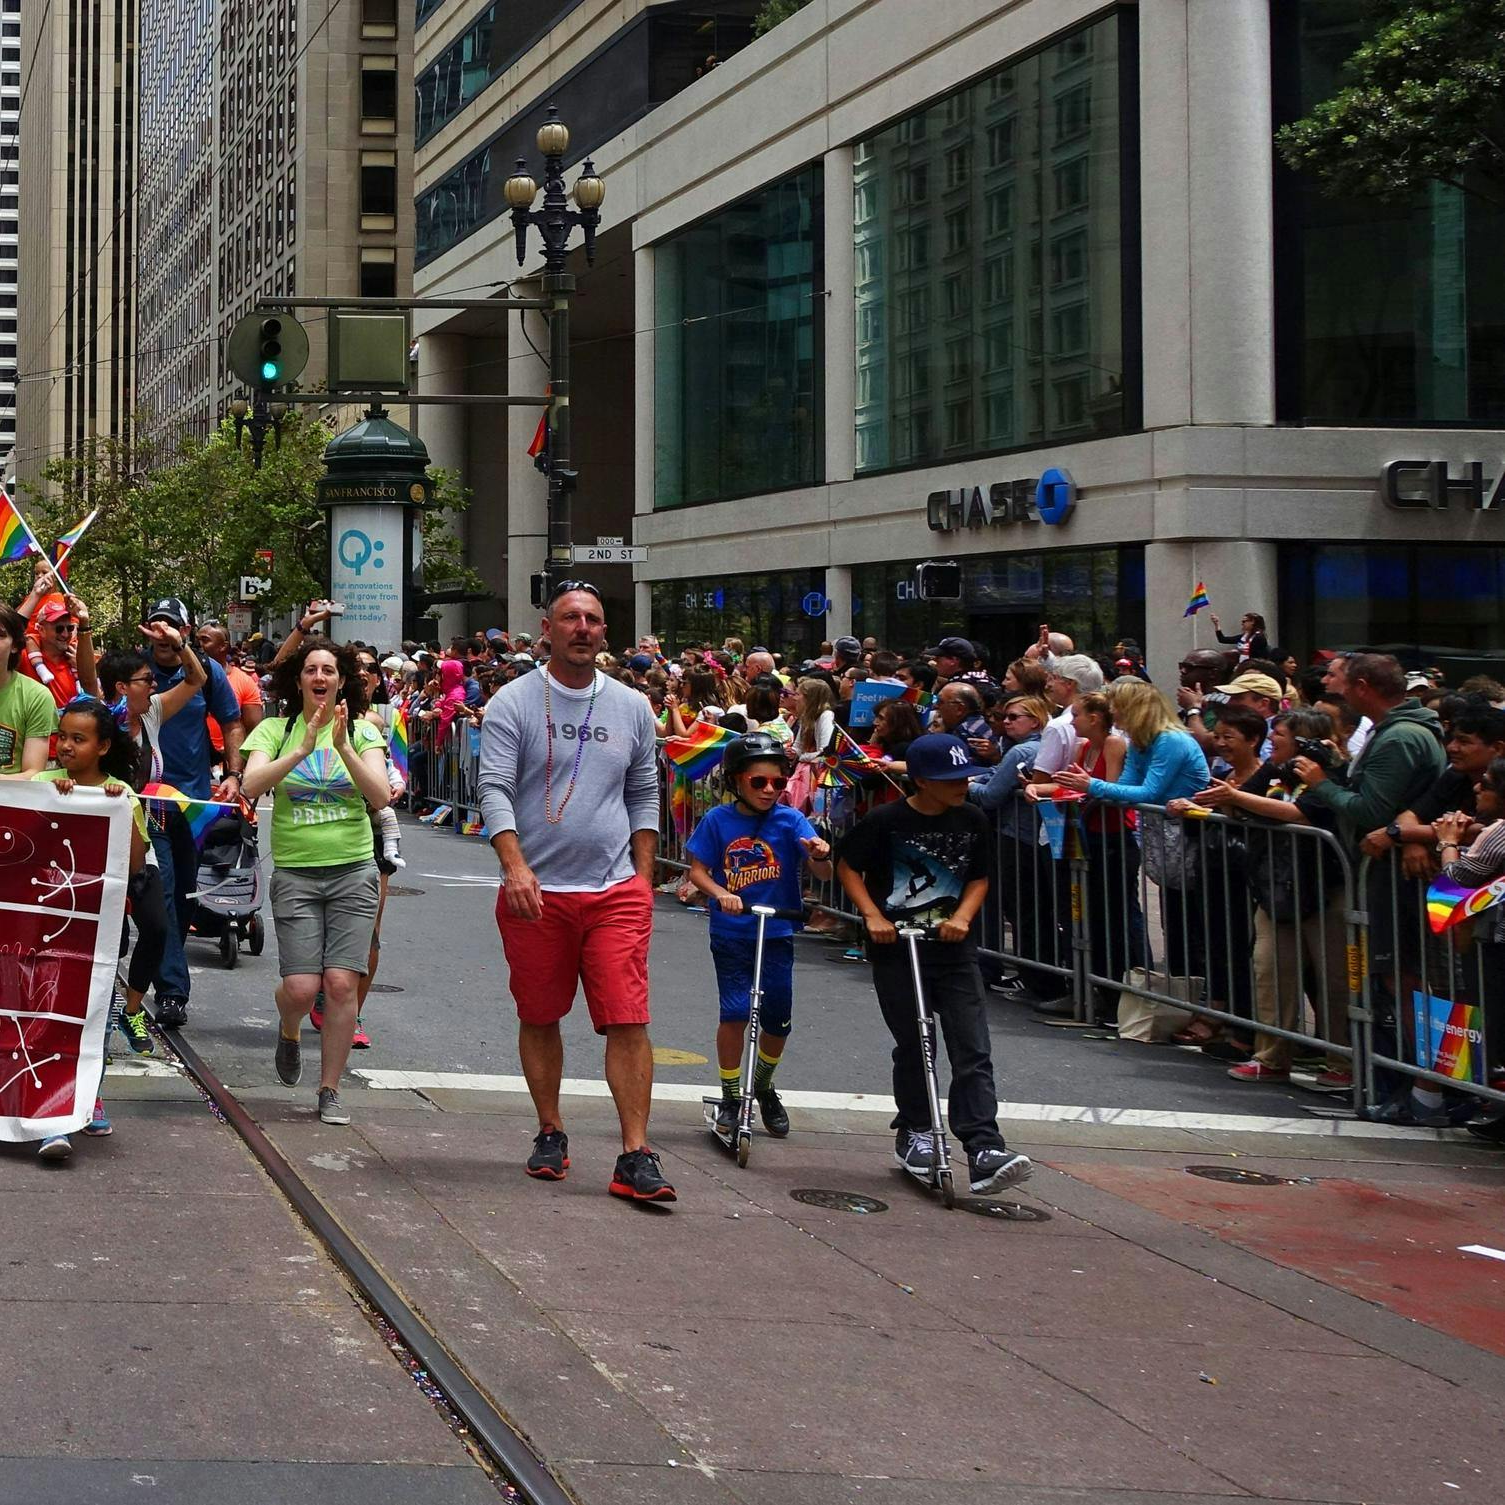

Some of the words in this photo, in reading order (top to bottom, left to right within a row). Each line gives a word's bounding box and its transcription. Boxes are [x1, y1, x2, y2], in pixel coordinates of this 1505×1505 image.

[342, 486, 397, 498] FRANCISCO
[927, 479, 1040, 531] CHASE
[588, 550, 612, 560] 2ND
[620, 550, 633, 560] ST
[348, 582, 393, 590] innovations
[379, 592, 399, 600] from
[359, 613, 387, 622] today?
[856, 693, 876, 702] Feel
[547, 722, 609, 743] 1966
[293, 806, 349, 825] PRIDE
[724, 864, 781, 893] WARRIORS
[1446, 1024, 1482, 1044] energy
